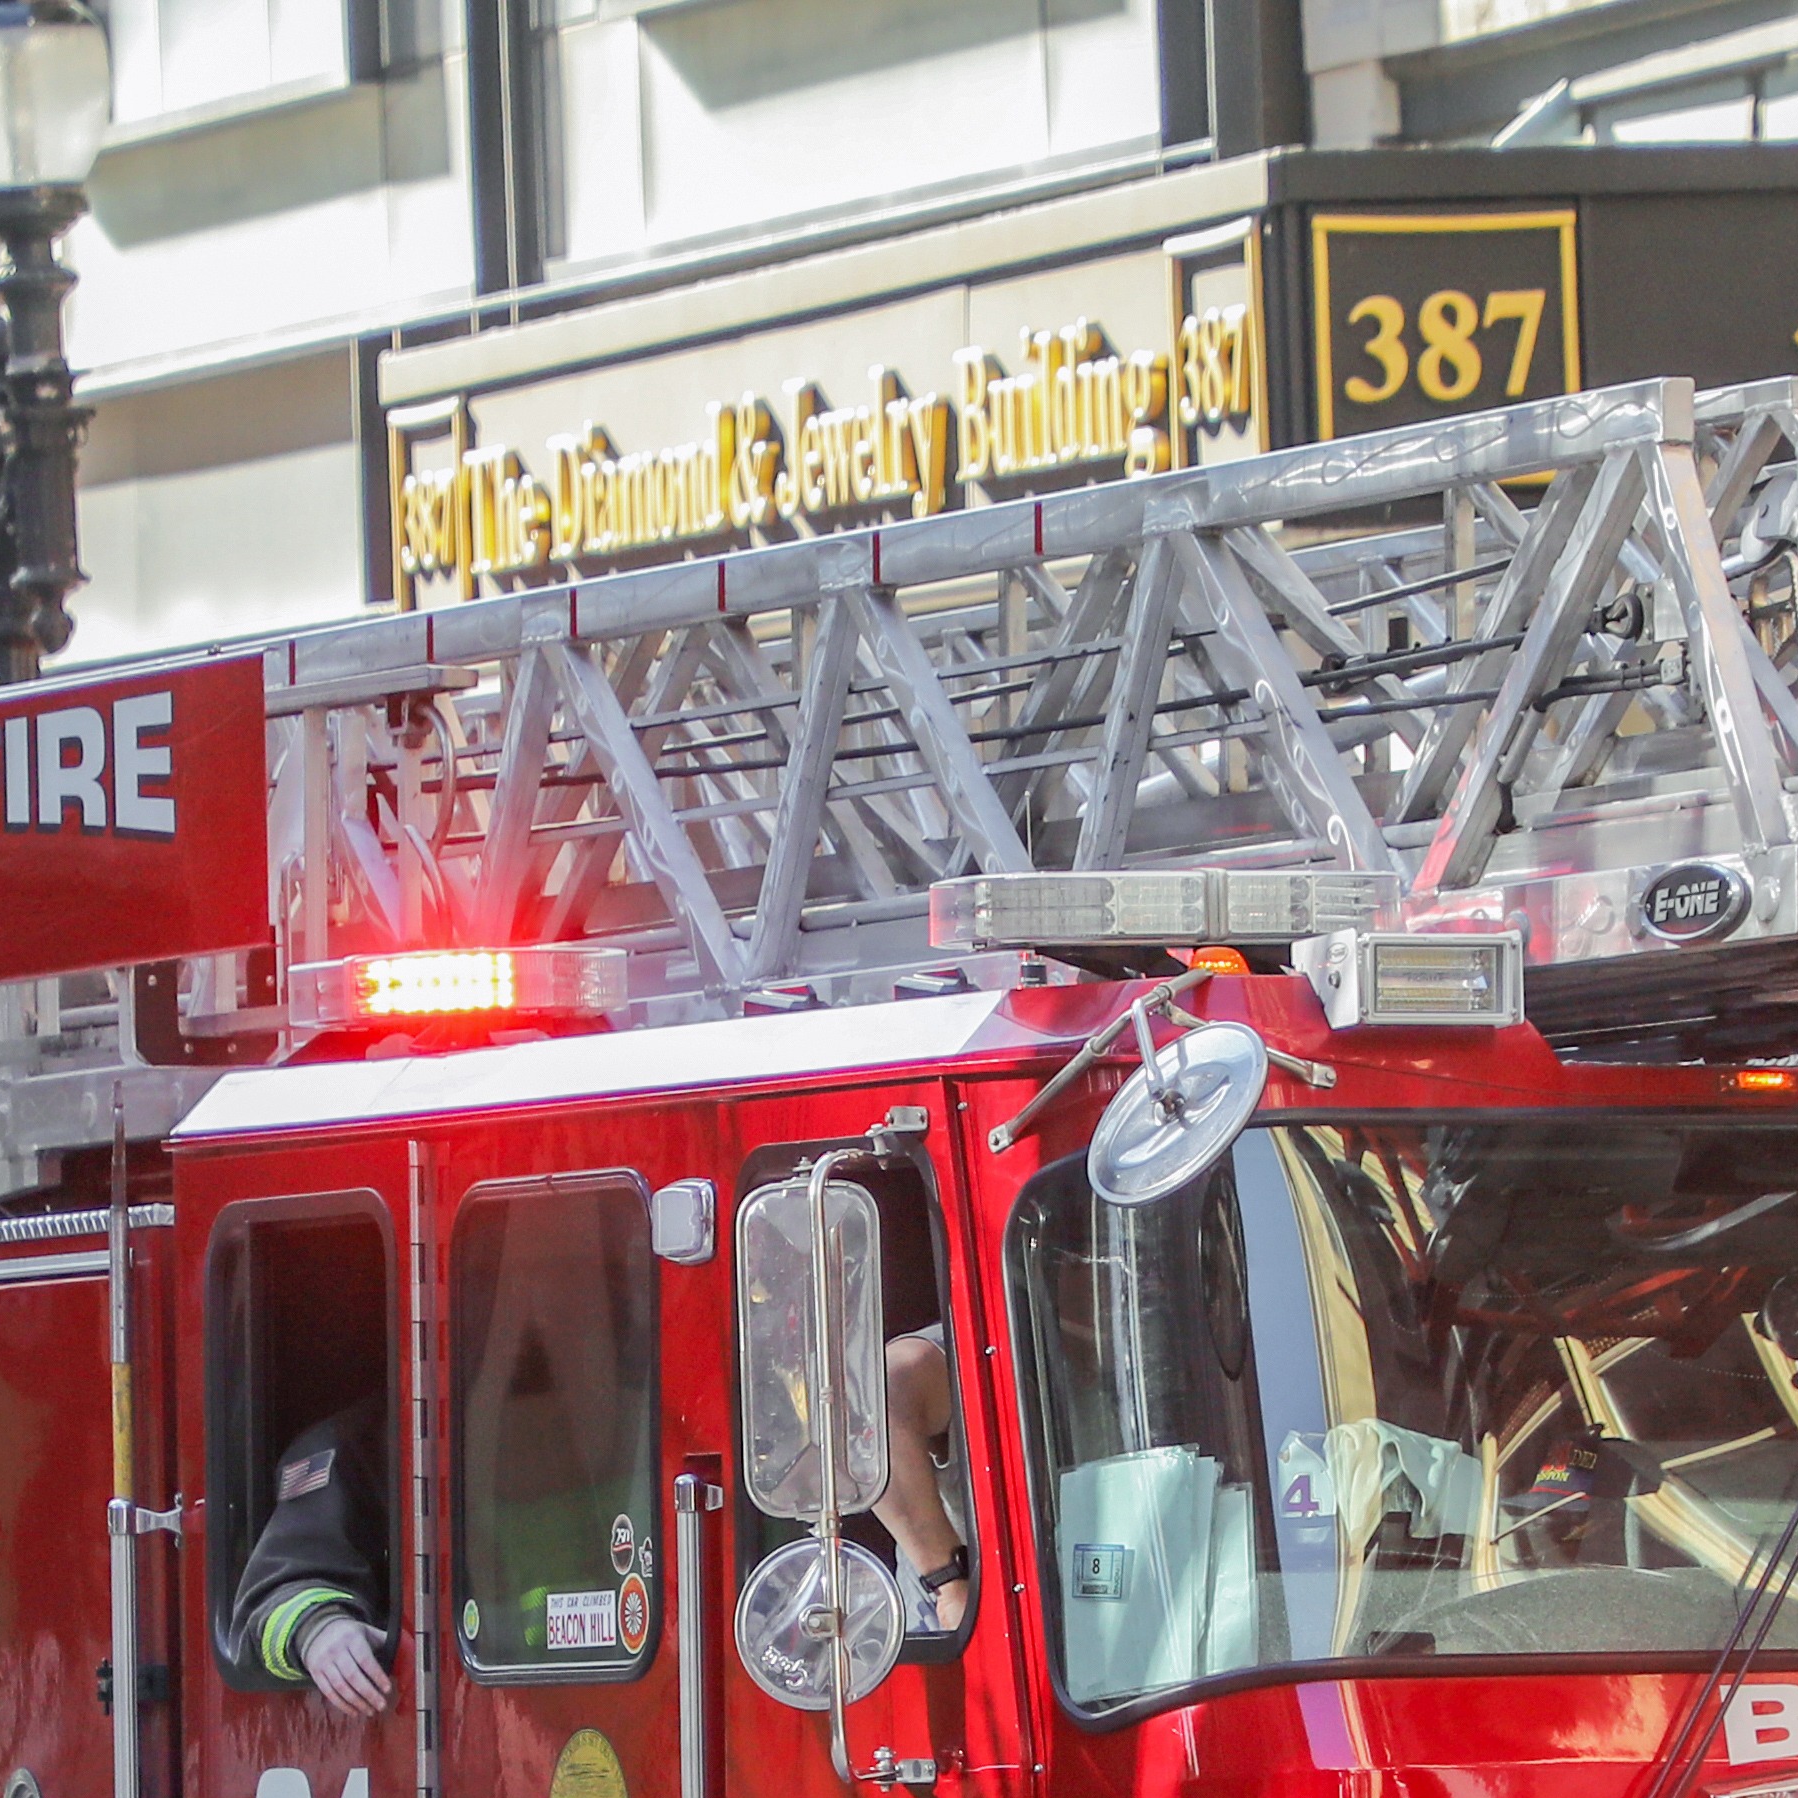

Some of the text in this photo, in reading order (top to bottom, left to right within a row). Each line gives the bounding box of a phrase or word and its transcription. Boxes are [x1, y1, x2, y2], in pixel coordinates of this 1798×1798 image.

[1179, 303, 1248, 425] 387
[1345, 290, 1545, 401] 387
[463, 315, 1164, 574] The Diamond & Jewelry Building
[1654, 879, 1720, 923] E-ONE
[548, 1612, 615, 1646] BEACON HILL
